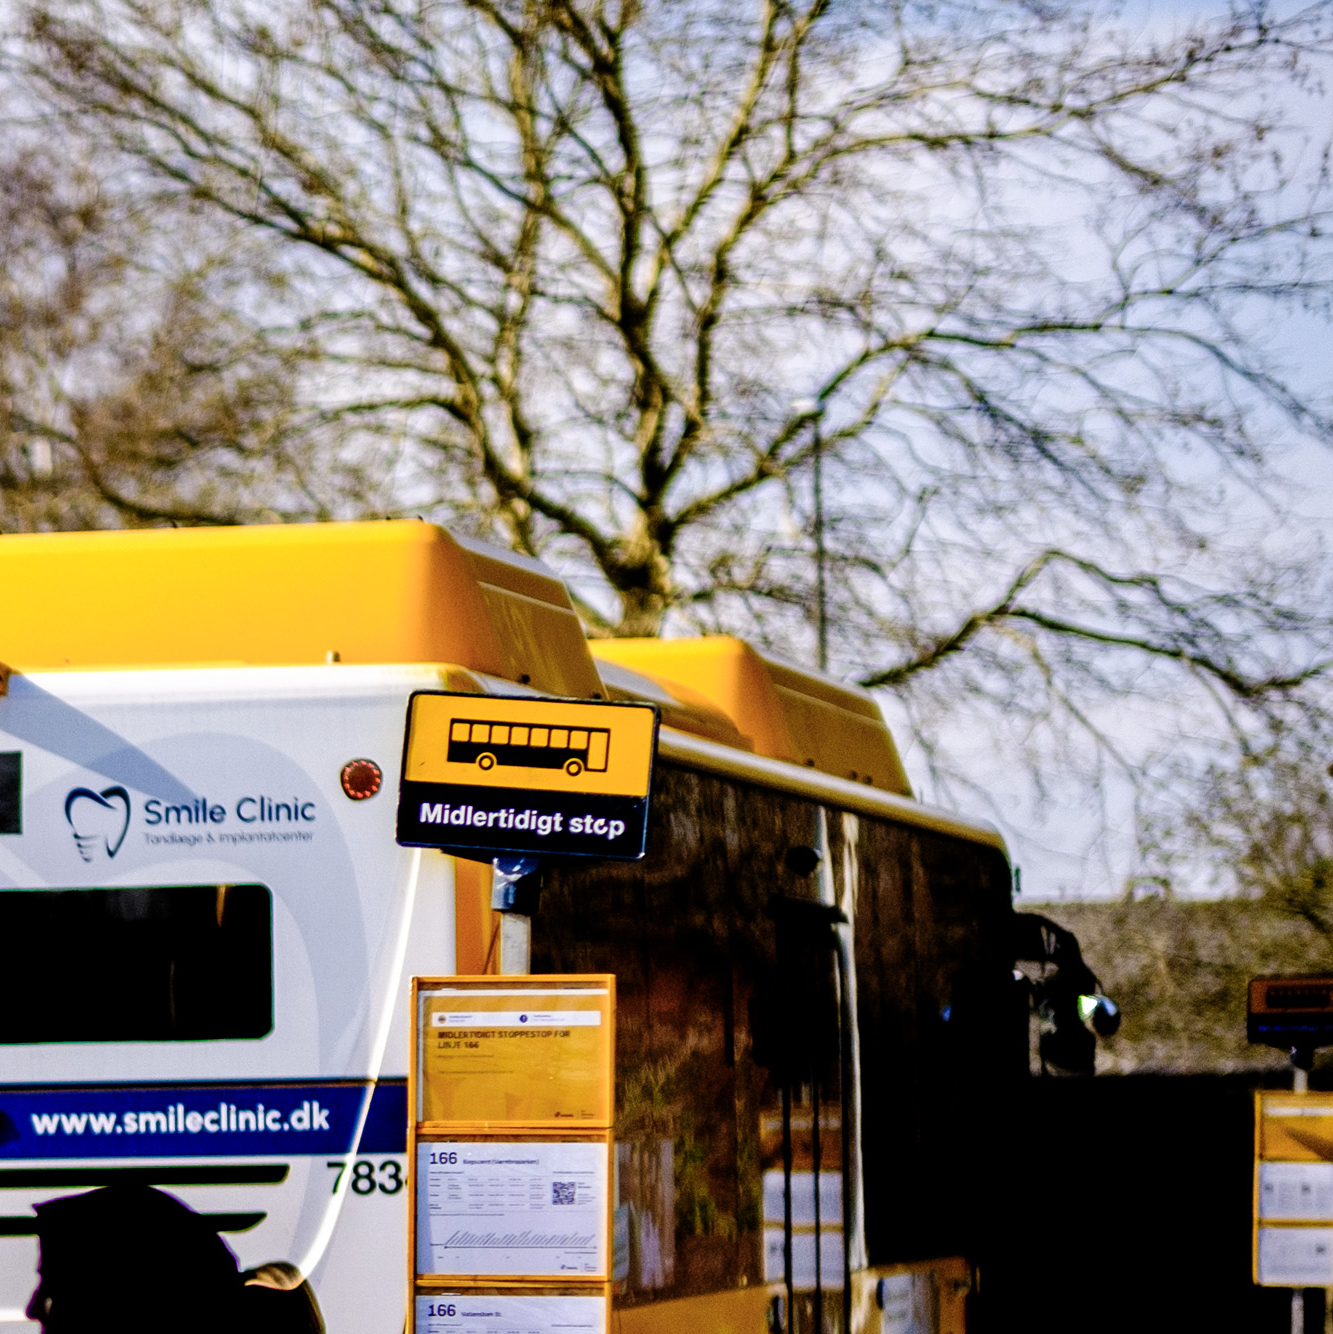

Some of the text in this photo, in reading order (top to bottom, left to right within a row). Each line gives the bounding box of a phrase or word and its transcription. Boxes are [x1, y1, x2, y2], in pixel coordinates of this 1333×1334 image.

[144, 795, 316, 825] Smile Clinic
[419, 802, 626, 841] Midlertidigt stop
[206, 832, 216, 844] &
[437, 1029, 571, 1040] MIDLERTIDIGT STOPPESTOP FOR
[437, 1041, 480, 1050] LINJE 166
[31, 1101, 331, 1135] www.smileclinic.dk
[429, 1152, 458, 1165] 166
[326, 1160, 409, 1195] 783
[428, 1304, 456, 1317] 166
